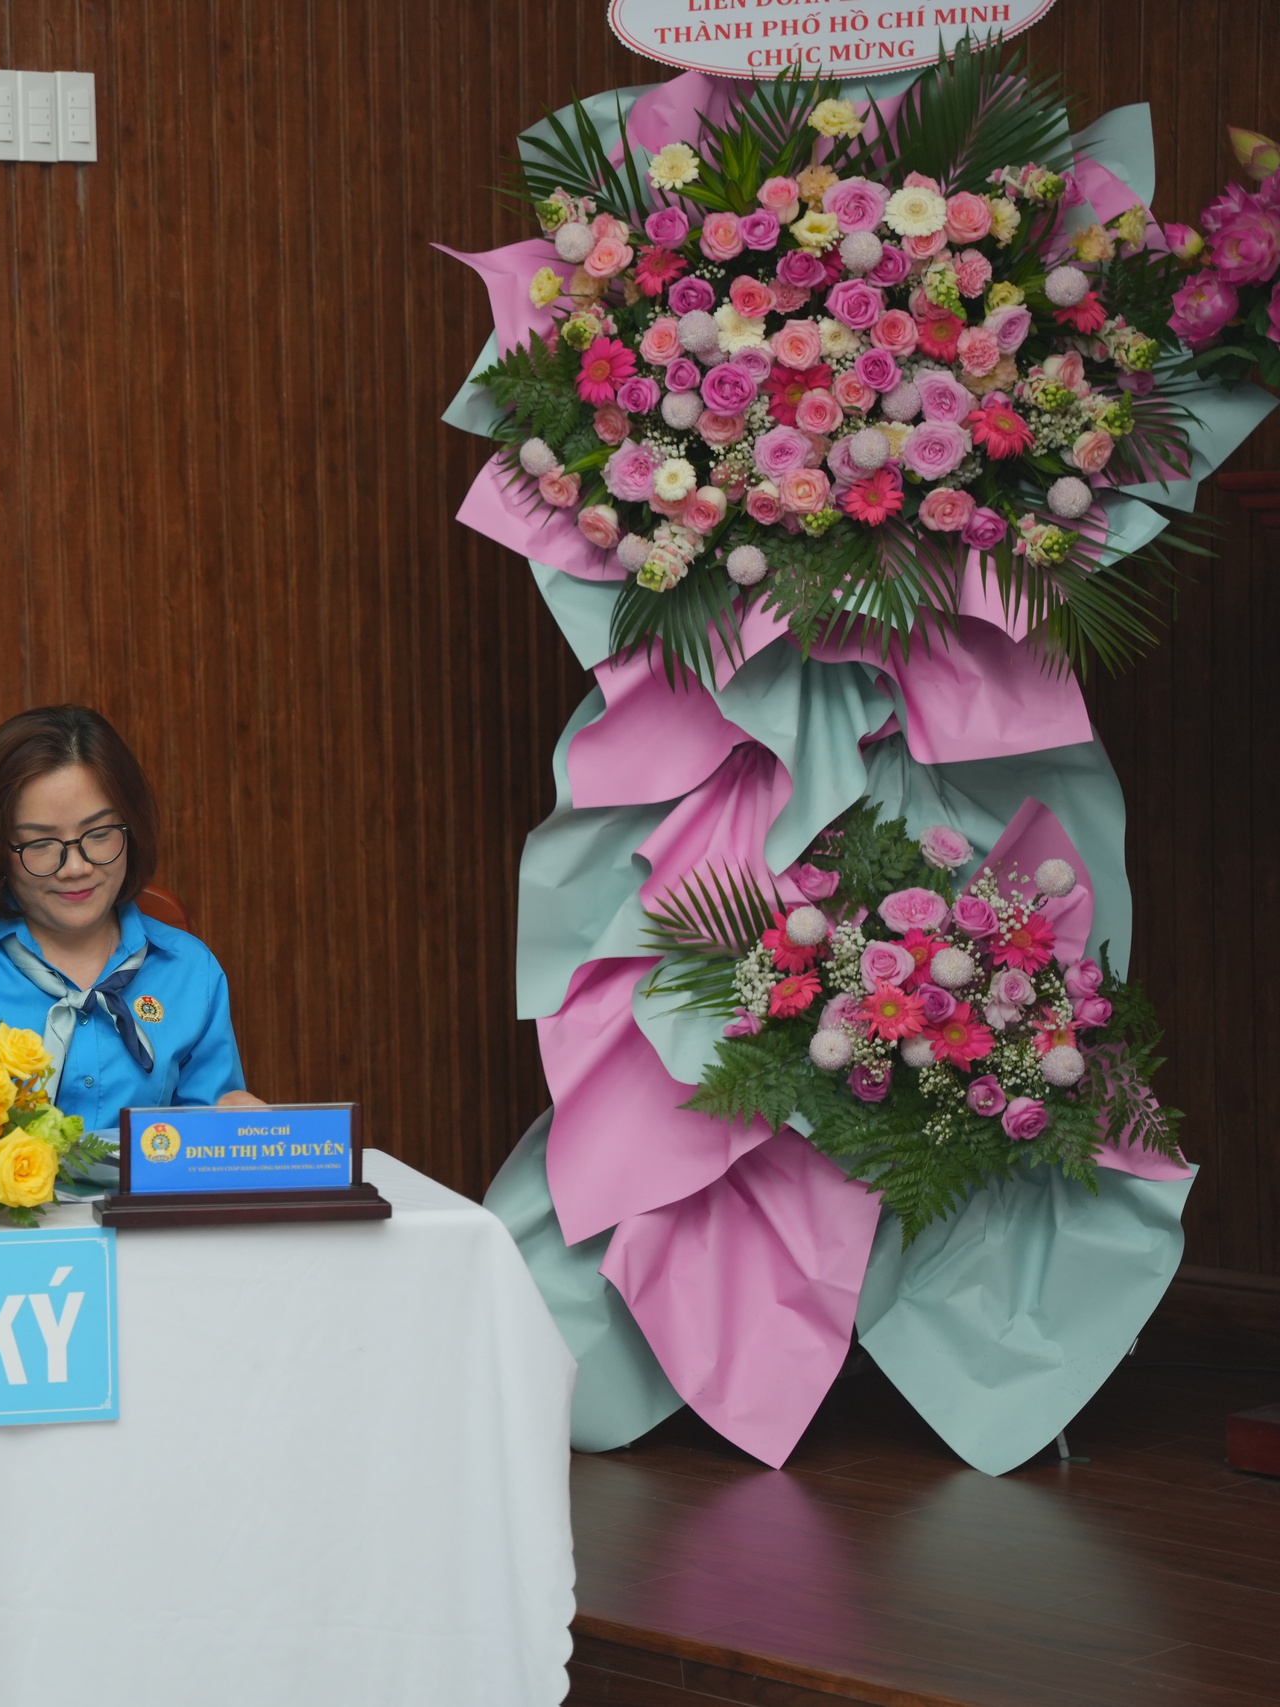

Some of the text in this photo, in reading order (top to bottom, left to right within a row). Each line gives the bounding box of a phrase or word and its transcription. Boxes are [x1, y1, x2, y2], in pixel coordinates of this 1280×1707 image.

[654, 4, 1011, 44] THÀNH PHỐ HỒ CHÍ MINH
[747, 38, 915, 67] CHÚC MỪNG
[185, 1139, 344, 1160] ĐINH THỊ MỸ DUYÊN
